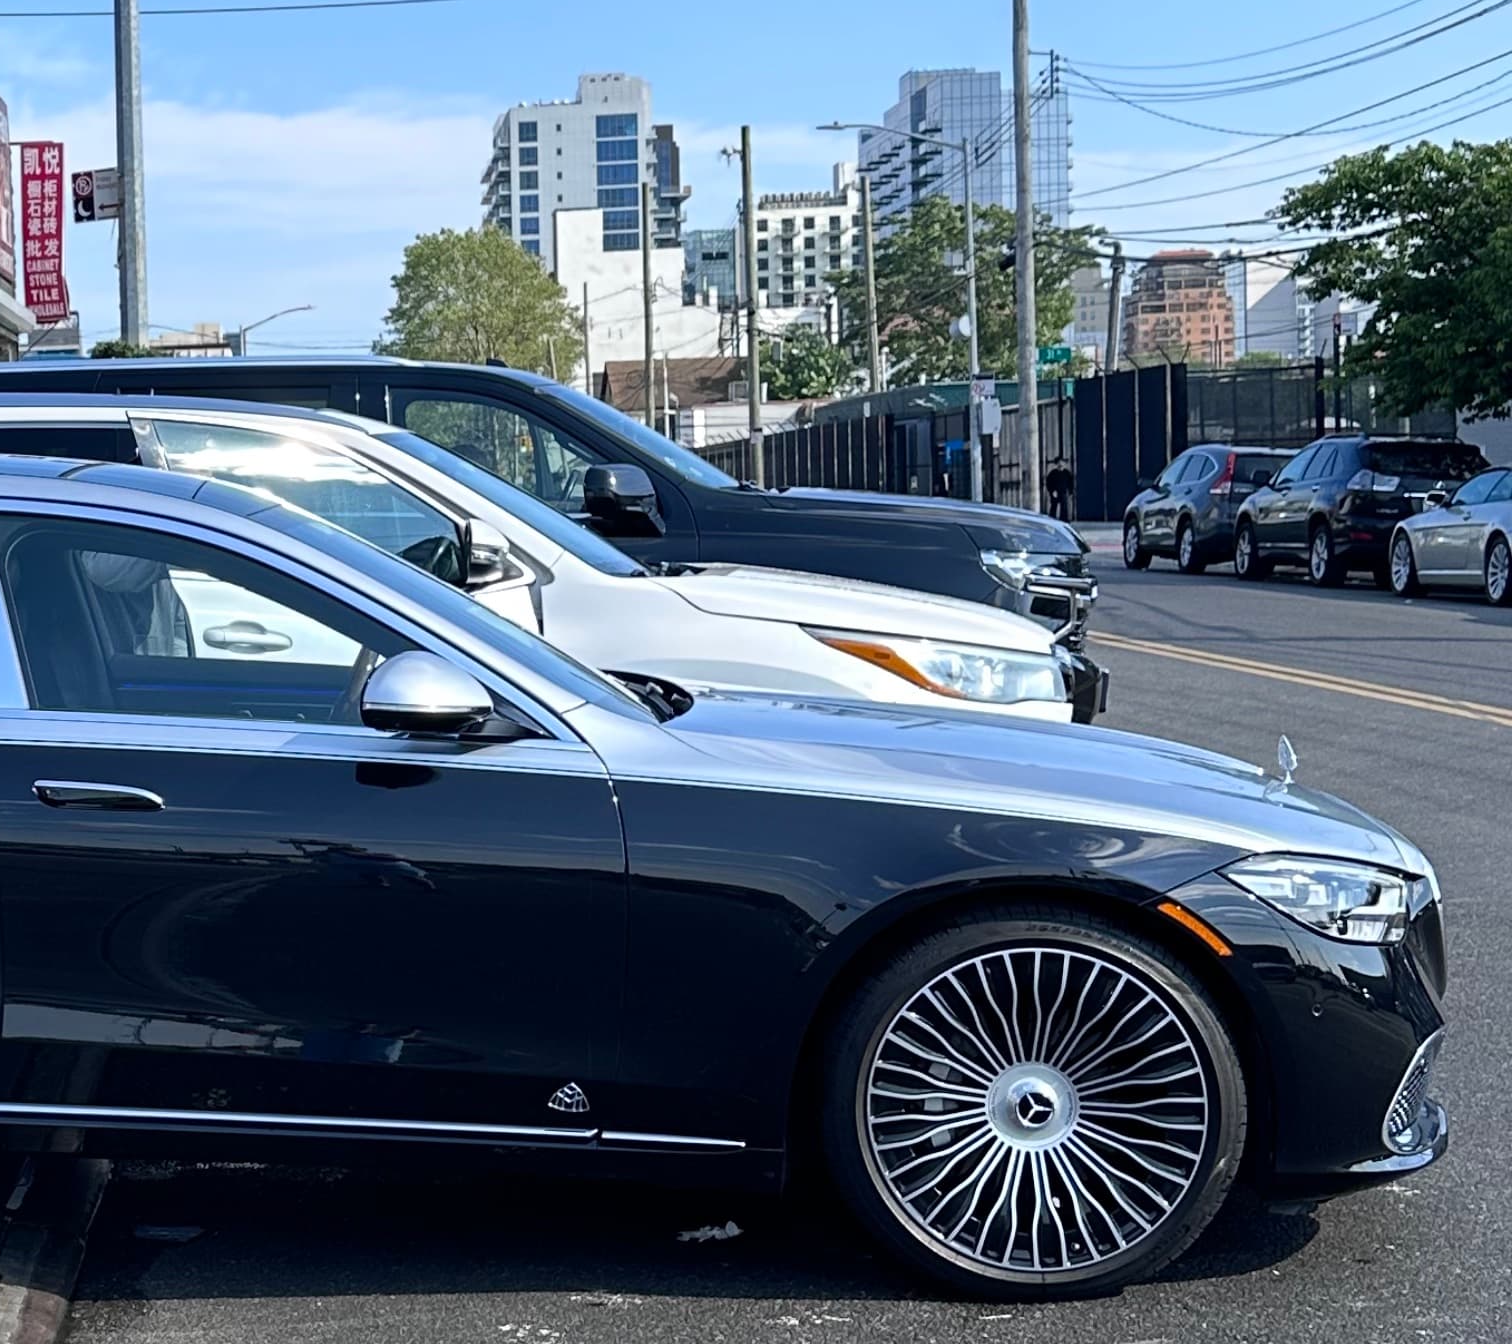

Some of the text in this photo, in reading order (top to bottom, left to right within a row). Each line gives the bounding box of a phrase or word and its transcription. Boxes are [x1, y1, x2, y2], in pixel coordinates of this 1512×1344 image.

[26, 238, 60, 258] 批发
[26, 258, 59, 273] CABINET
[28, 272, 58, 287] STONE
[30, 288, 60, 303] TILE
